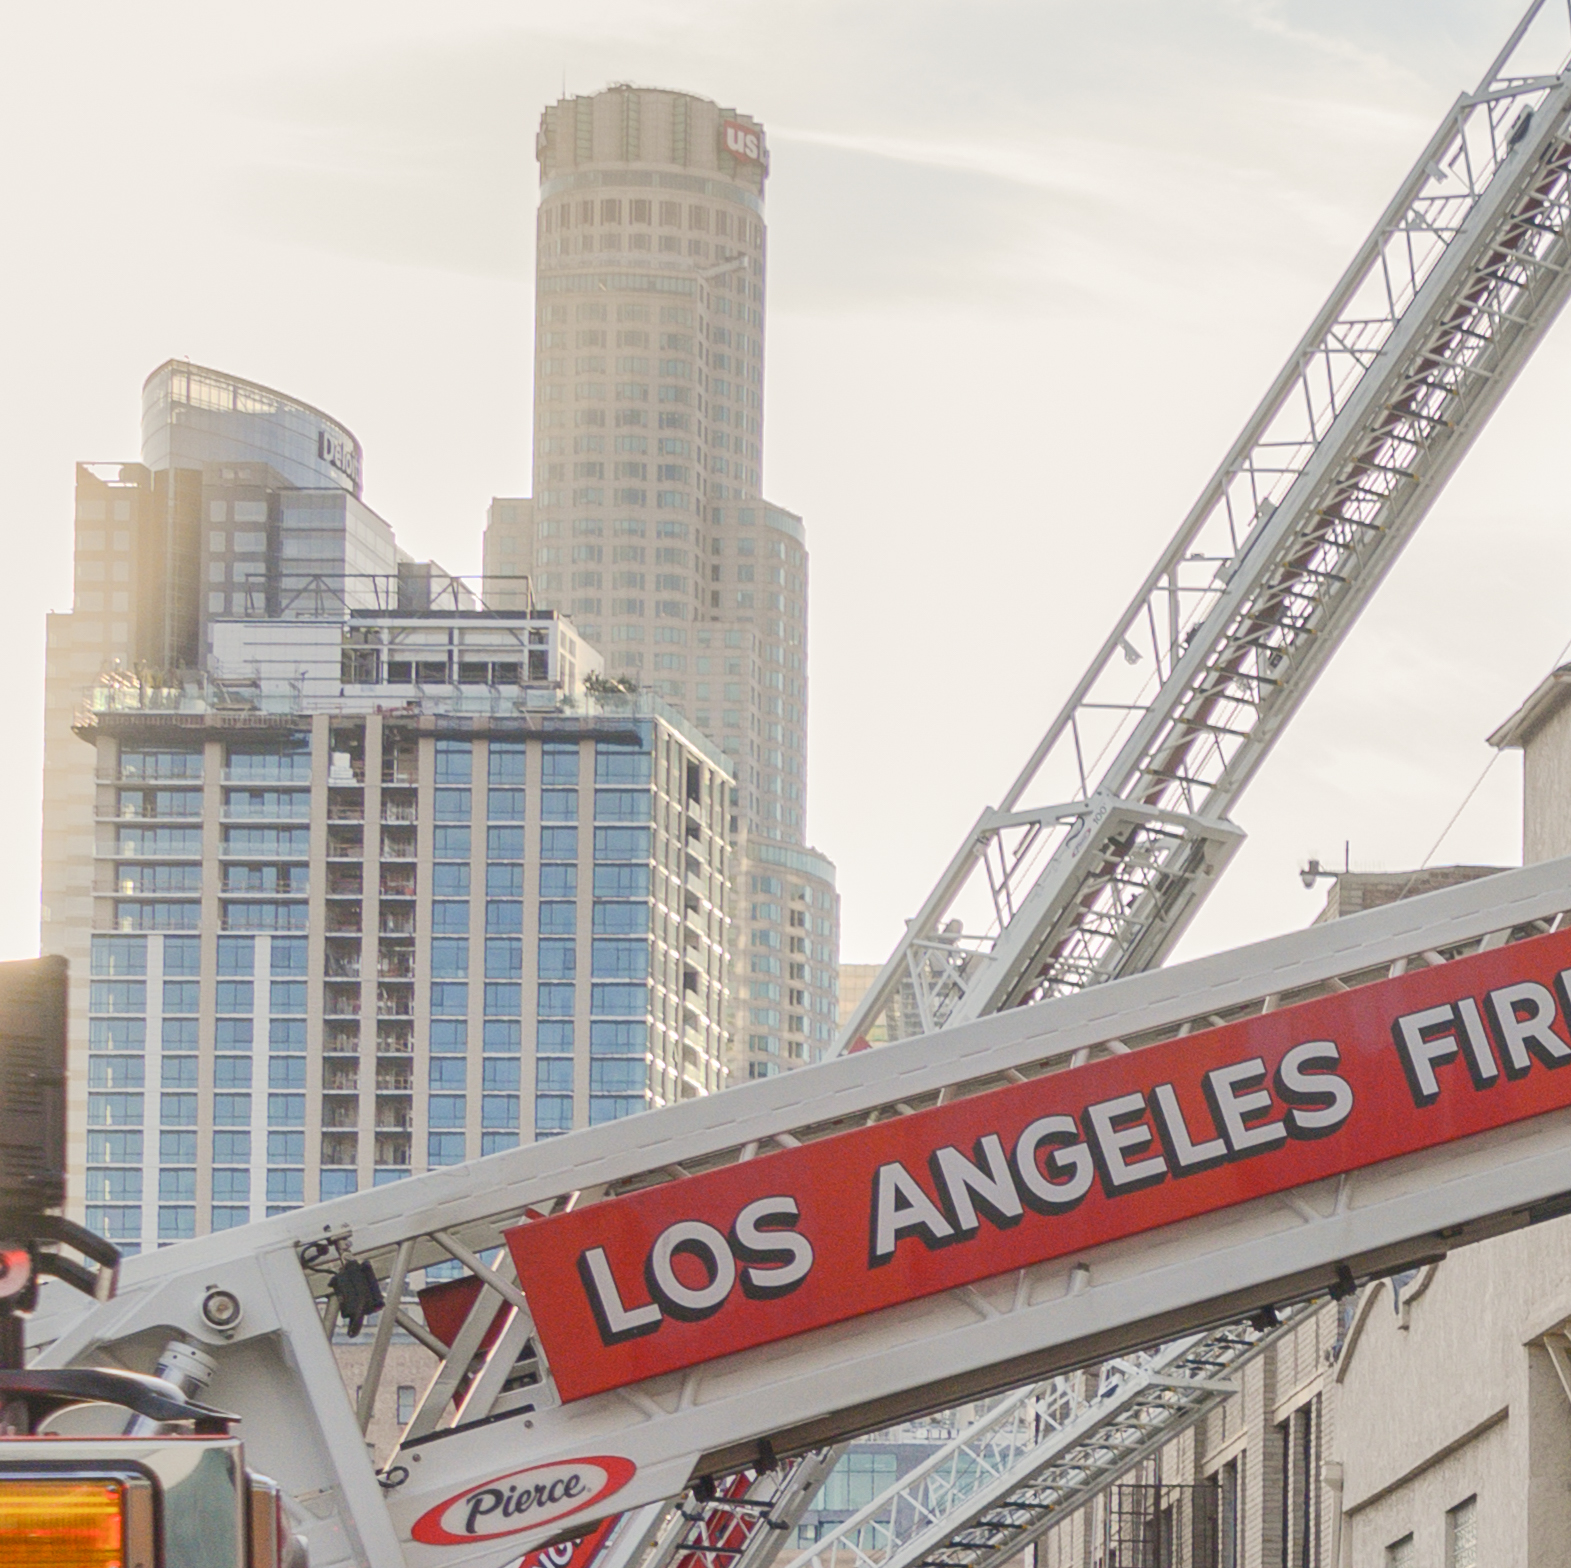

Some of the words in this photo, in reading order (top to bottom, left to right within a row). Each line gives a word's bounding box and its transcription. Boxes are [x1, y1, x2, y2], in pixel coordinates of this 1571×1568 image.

[580, 1195, 816, 1343] LOS
[869, 1039, 1356, 1268] ANGELES
[466, 1473, 586, 1535] Pierce
